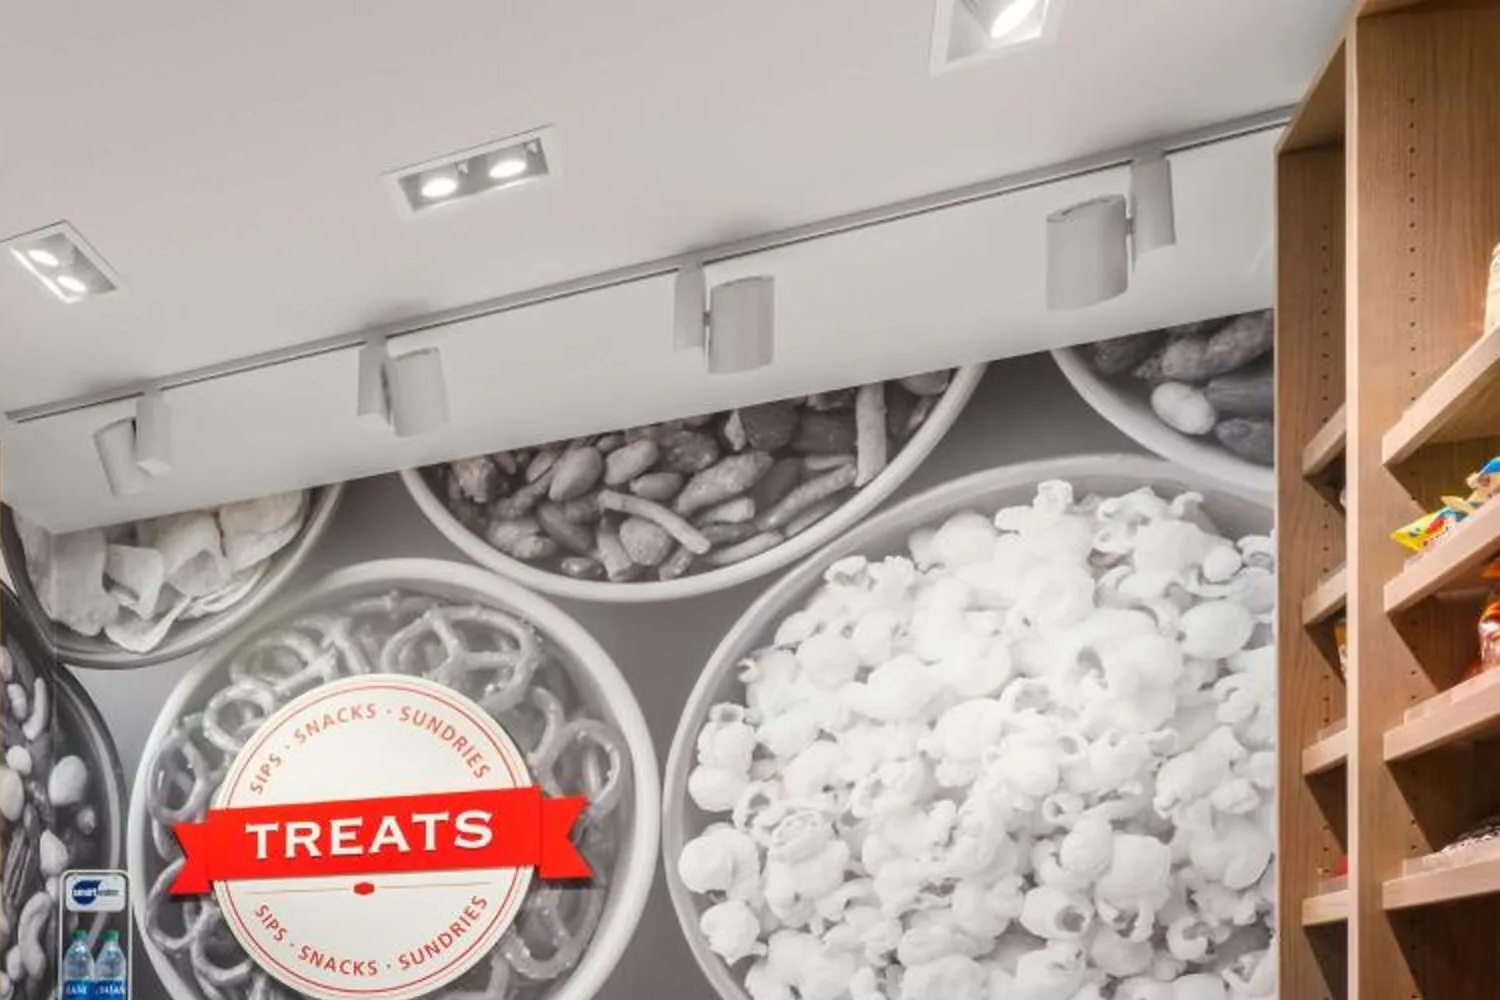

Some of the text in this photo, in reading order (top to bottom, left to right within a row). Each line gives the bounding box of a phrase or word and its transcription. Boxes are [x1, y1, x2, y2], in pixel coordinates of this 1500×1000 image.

[248, 702, 492, 797] SIPS SNACKS SUNDRIES
[244, 810, 495, 861] TREATS
[253, 894, 489, 977] SIPS SNACKS SUNDRIES
